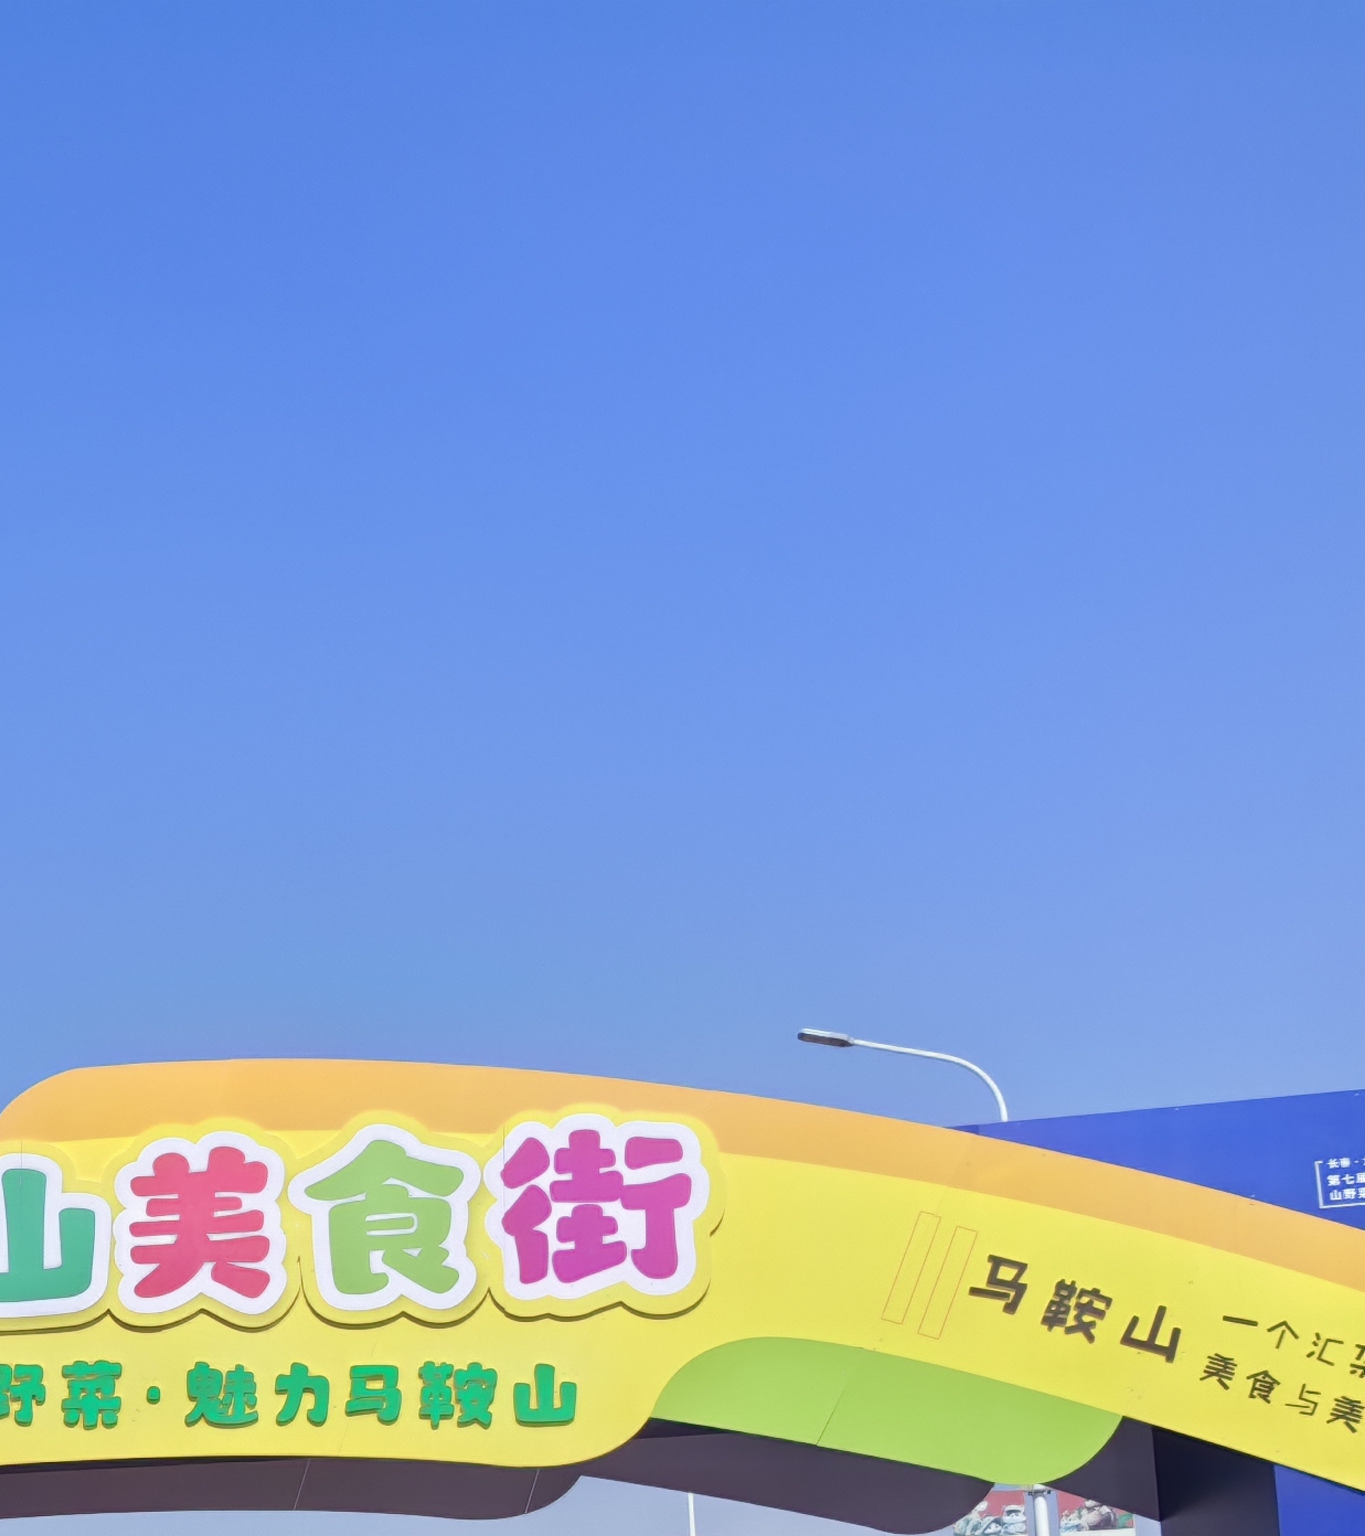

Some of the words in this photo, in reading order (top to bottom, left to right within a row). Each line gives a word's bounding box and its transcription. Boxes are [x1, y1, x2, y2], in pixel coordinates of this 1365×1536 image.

[968, 1254, 1182, 1363] 马鞍山
[1199, 1352, 1365, 1434] 美食与美
